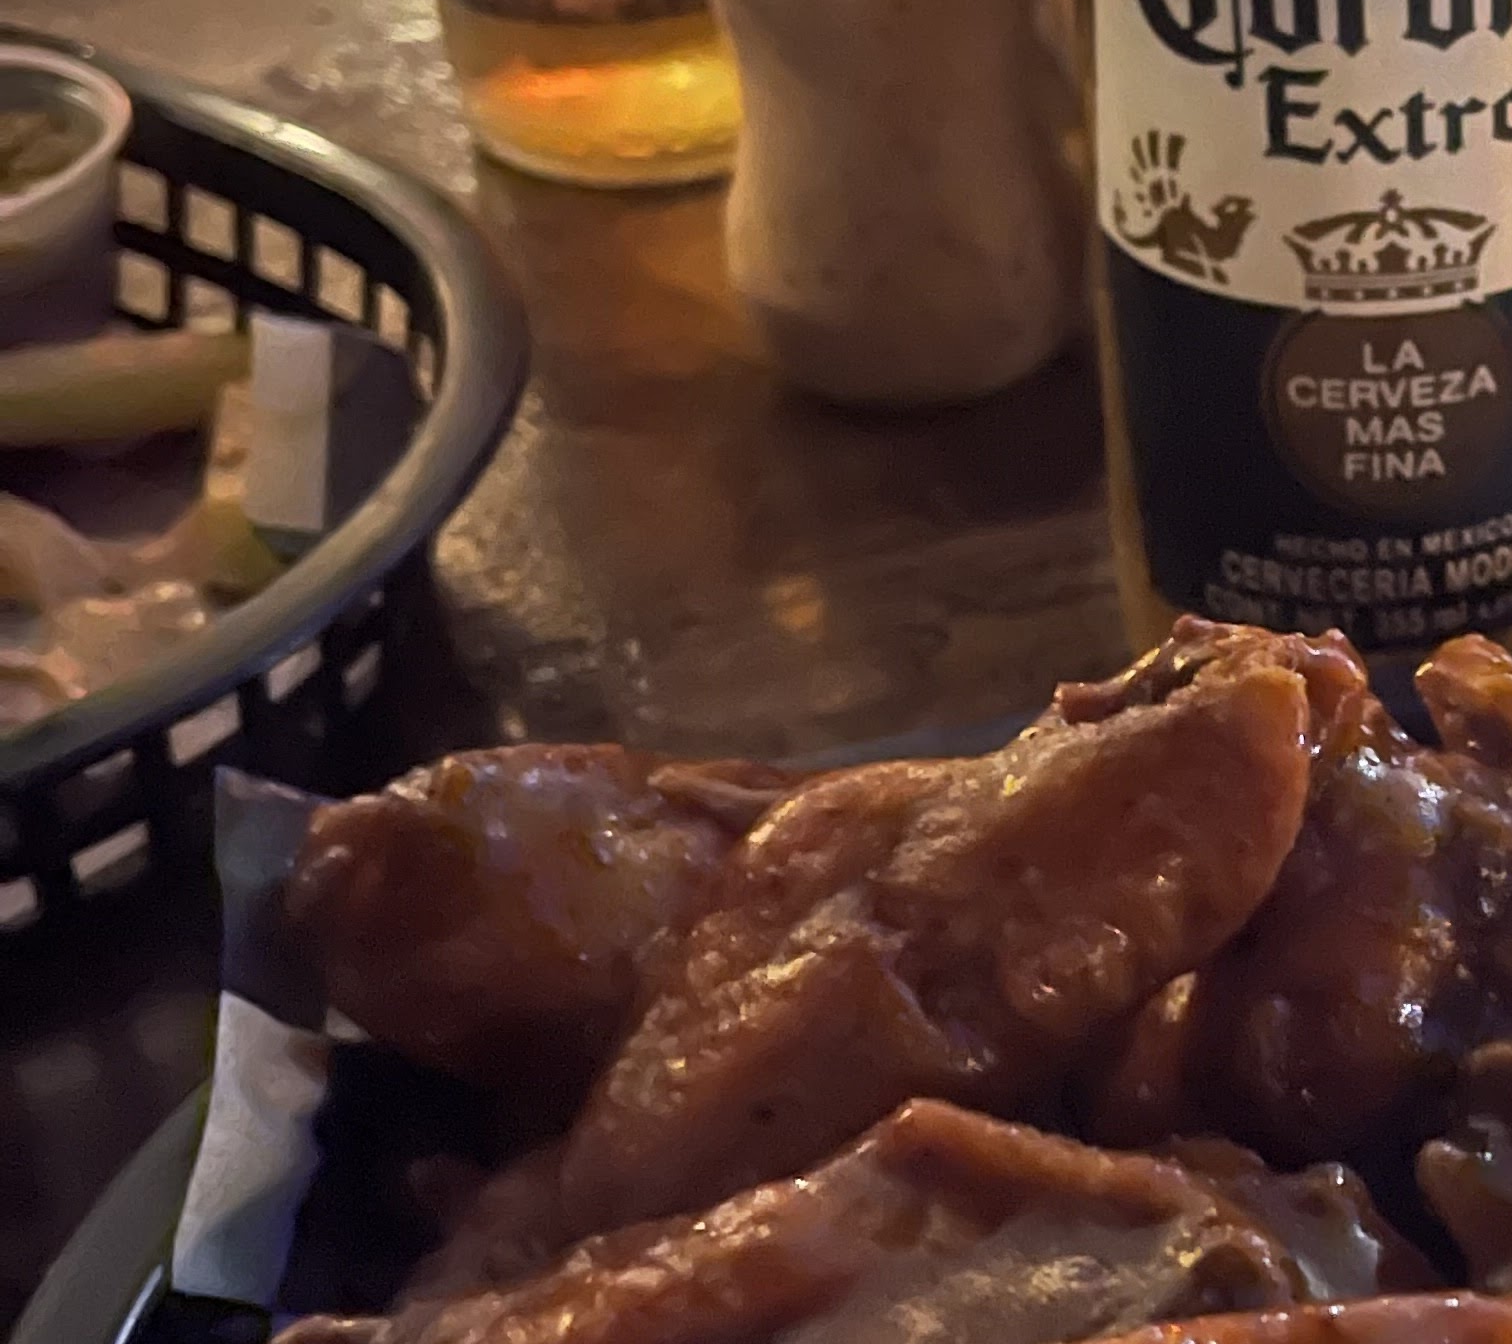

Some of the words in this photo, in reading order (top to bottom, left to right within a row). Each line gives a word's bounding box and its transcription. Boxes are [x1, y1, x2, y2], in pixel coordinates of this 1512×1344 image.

[1361, 340, 1426, 373] LA
[1286, 365, 1497, 410] CERVEZA
[1345, 413, 1445, 445] MAS
[1343, 450, 1446, 481] FINA
[1220, 548, 1435, 603] CERVECERIA
